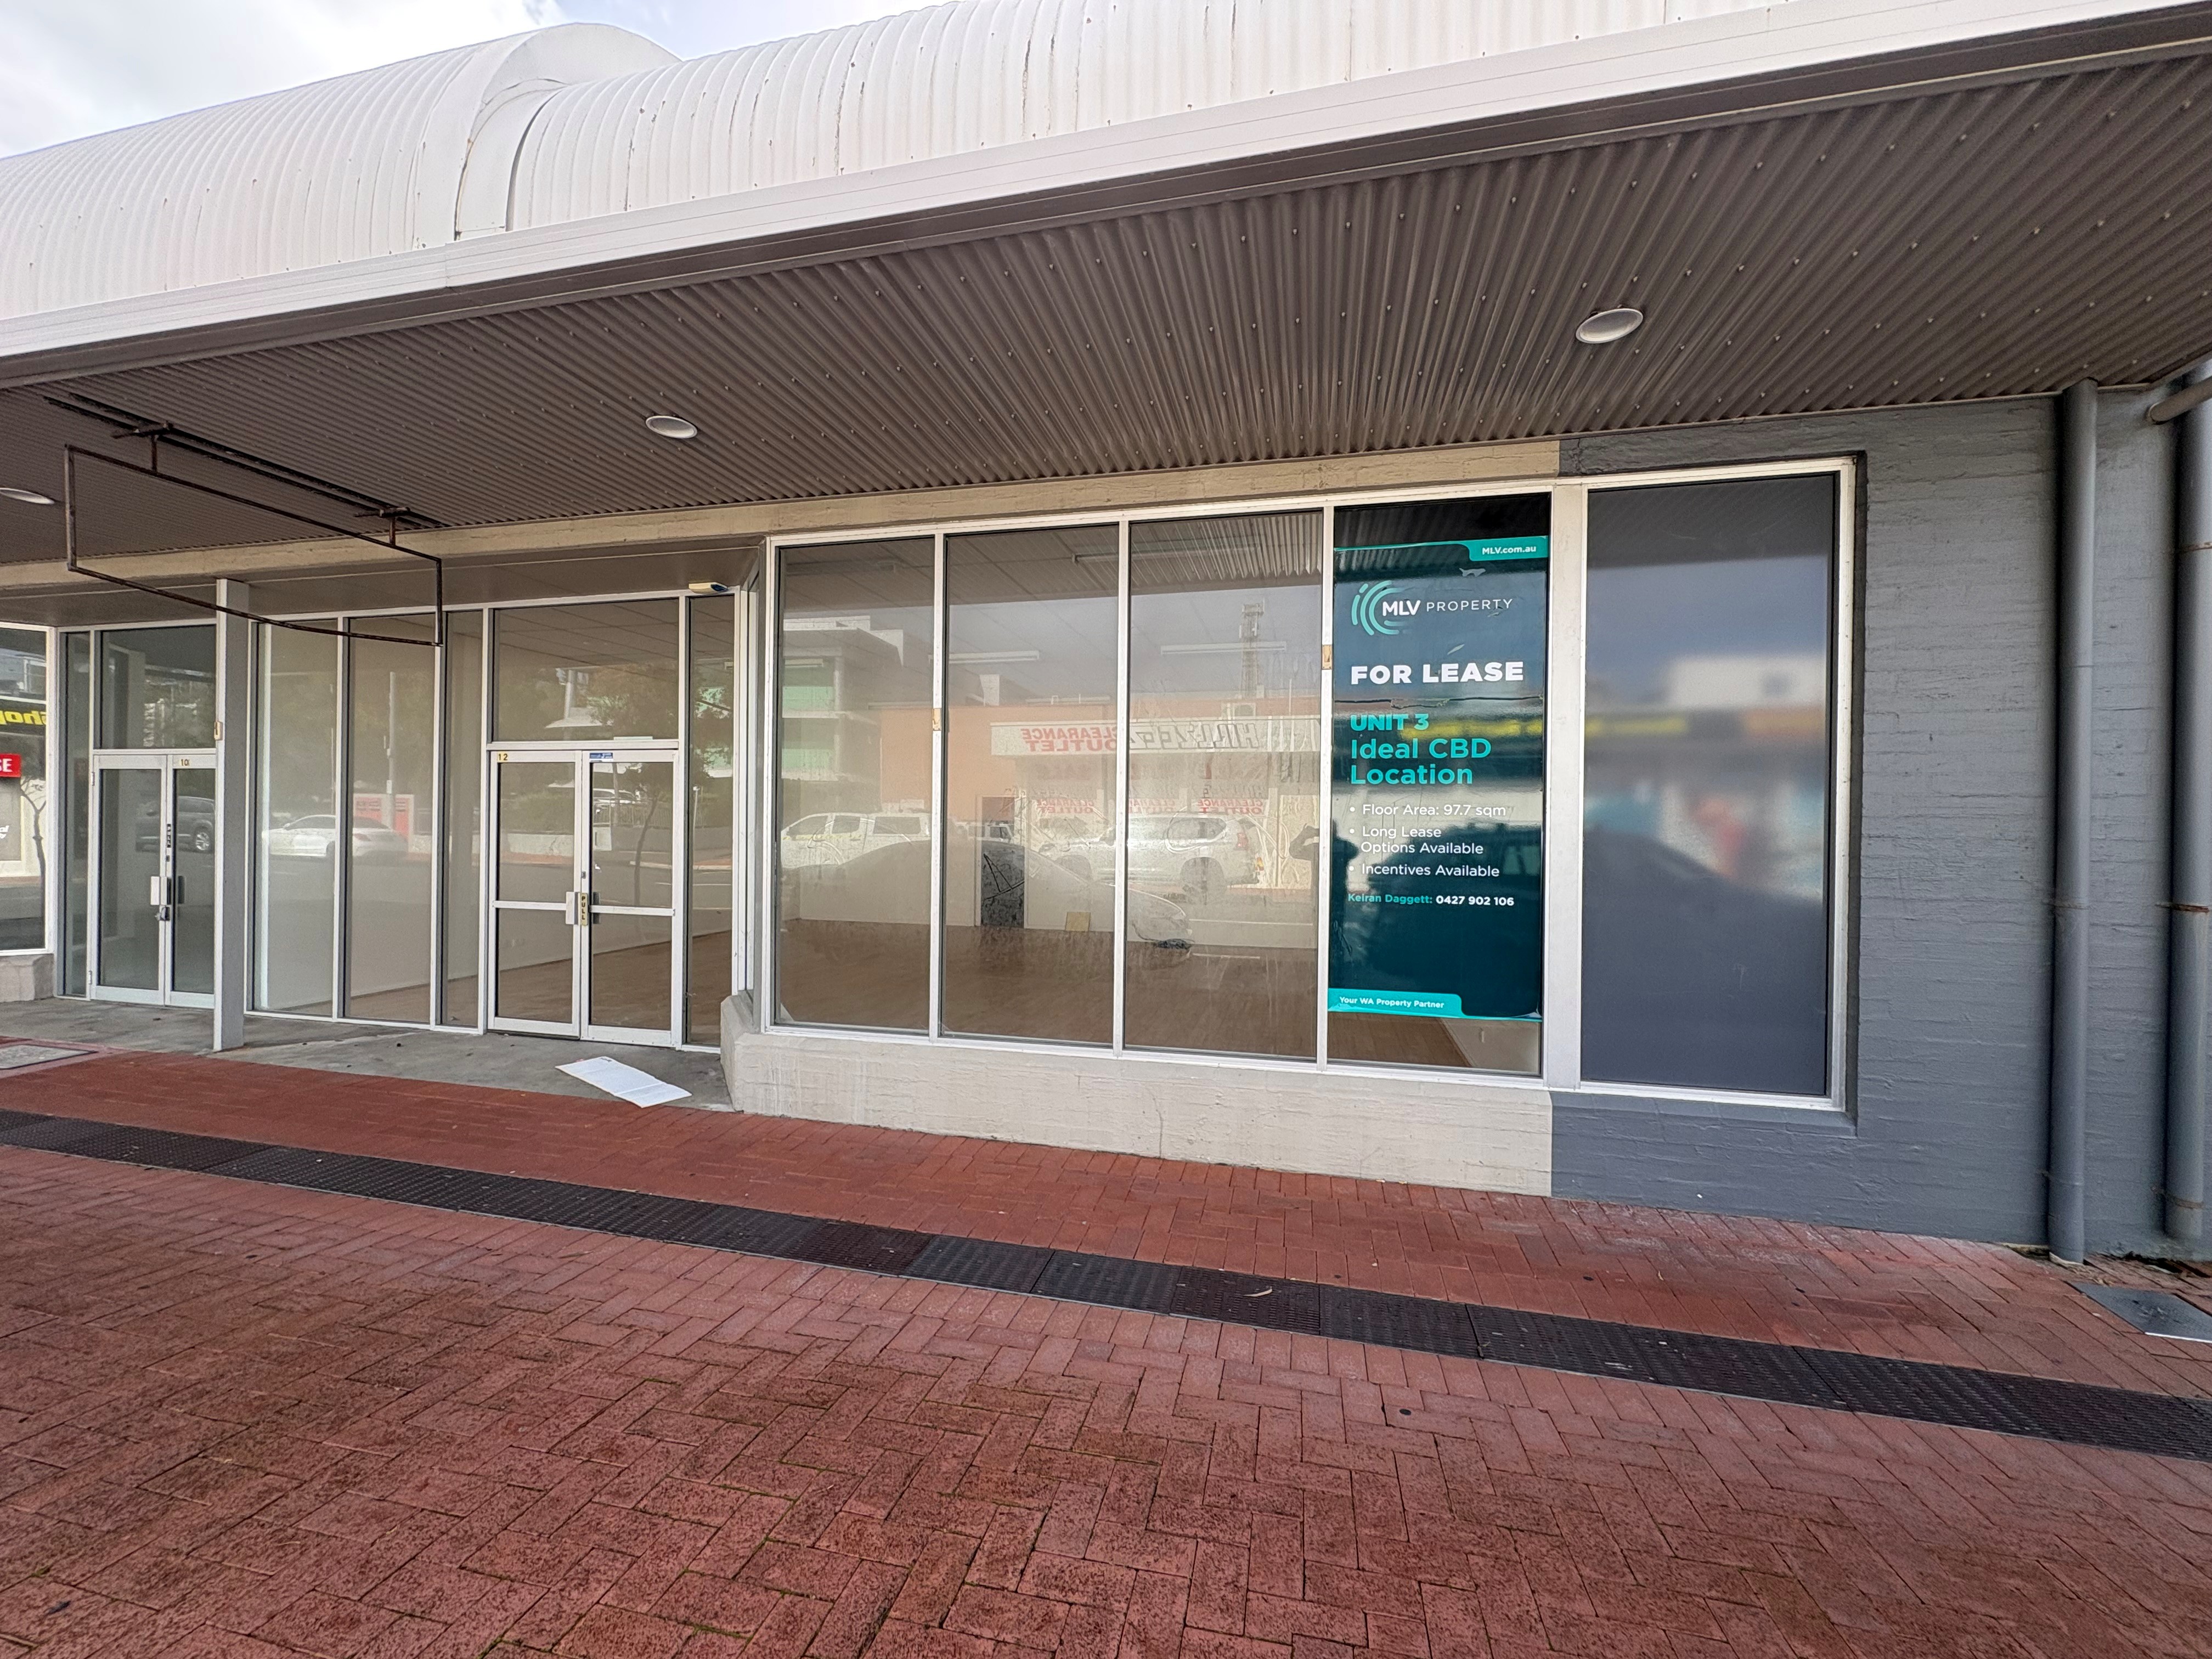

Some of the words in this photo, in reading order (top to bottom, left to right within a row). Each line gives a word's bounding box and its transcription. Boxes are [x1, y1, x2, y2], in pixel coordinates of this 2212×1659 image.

[1482, 545, 1536, 555] MLV.com.au
[1382, 600, 1421, 617] MLV
[1426, 599, 1513, 612] PROPERTY
[1351, 665, 1412, 685] FOR
[1423, 661, 1524, 683] LEASE
[1350, 713, 1409, 731] UNIT
[1414, 713, 1429, 731] 3
[1351, 738, 1418, 759] Ideal
[1429, 738, 1492, 759] CBD
[1351, 764, 1472, 785] Location
[1363, 804, 1398, 815] Floor
[1403, 805, 1440, 815] Area:
[1443, 805, 1471, 815] 97.7
[1476, 805, 1506, 817] sqm
[1362, 827, 1396, 838] Long
[1402, 827, 1441, 837] Lease
[1361, 842, 1415, 855] Options
[1419, 843, 1483, 854] Available
[1362, 864, 1431, 876] Incentives
[1435, 865, 1499, 877] Available
[1348, 894, 1381, 902] Keiran
[1385, 894, 1432, 905] Daggett:
[1436, 895, 1465, 905] 0427
[1468, 896, 1491, 905] 902
[1494, 896, 1514, 906] 106
[1340, 996, 1358, 1005] Your
[1376, 998, 1412, 1008] Property
